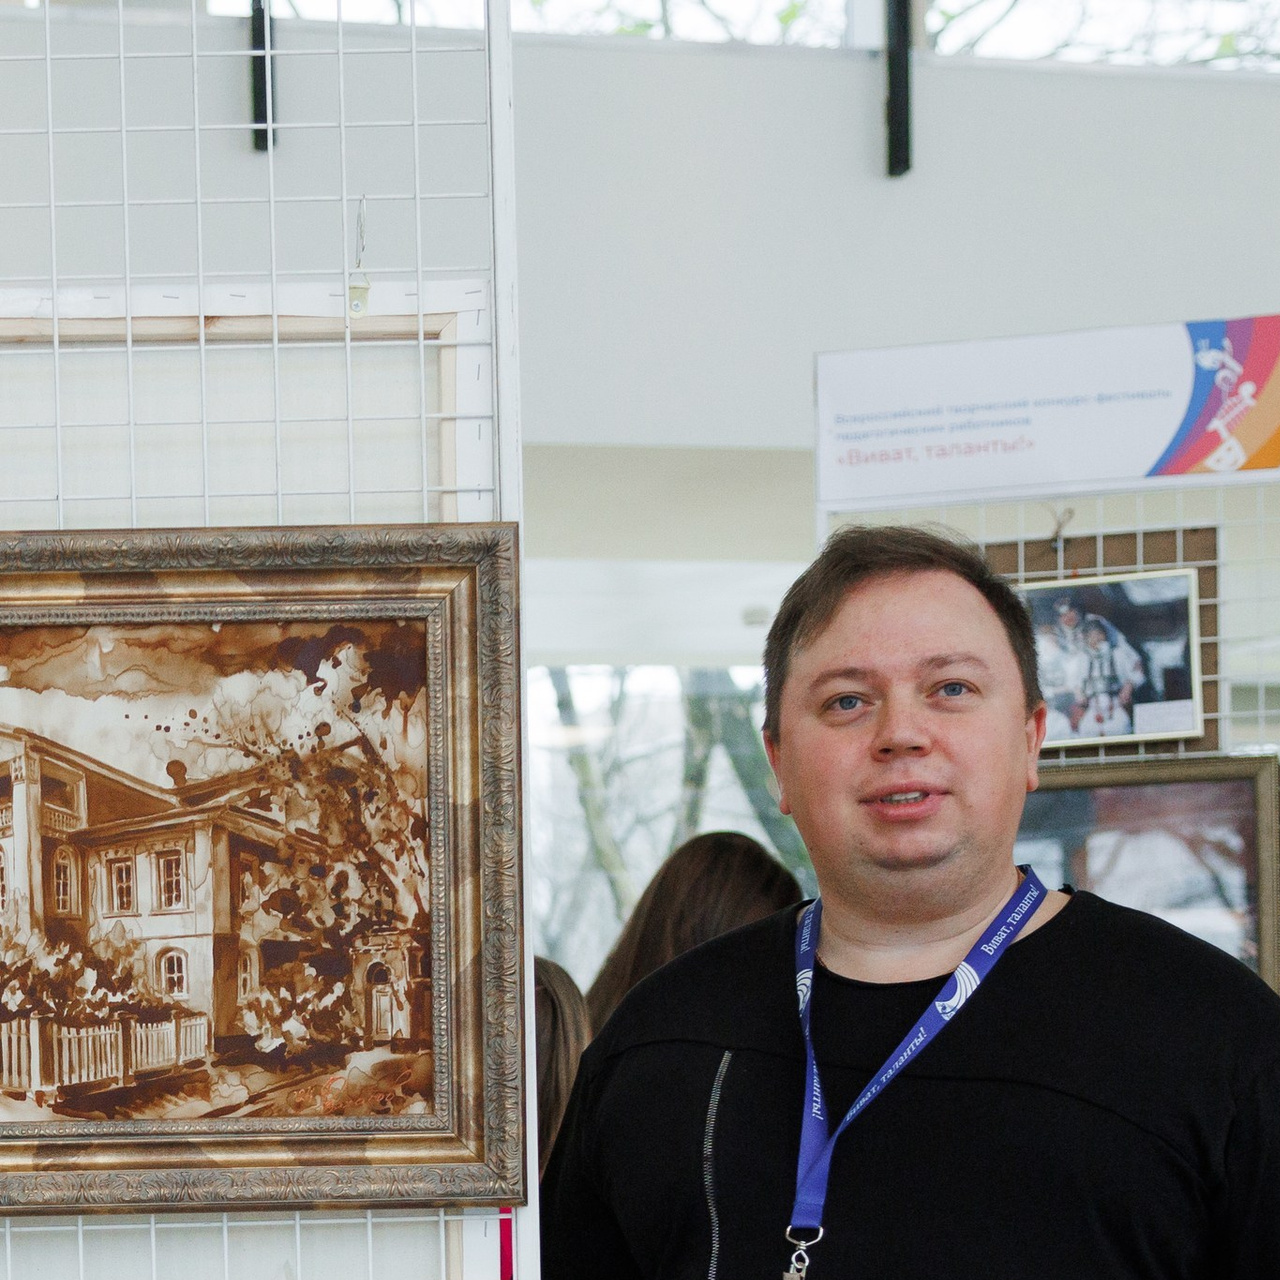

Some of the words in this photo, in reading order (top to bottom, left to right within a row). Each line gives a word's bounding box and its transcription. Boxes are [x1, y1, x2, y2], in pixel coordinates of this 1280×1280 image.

[837, 447, 921, 468] «Виват,
[925, 435, 1035, 462] таланты!»
[980, 925, 1014, 956] Виват,
[1006, 884, 1040, 925] таланты!
[880, 1026, 928, 1083] таланты!
